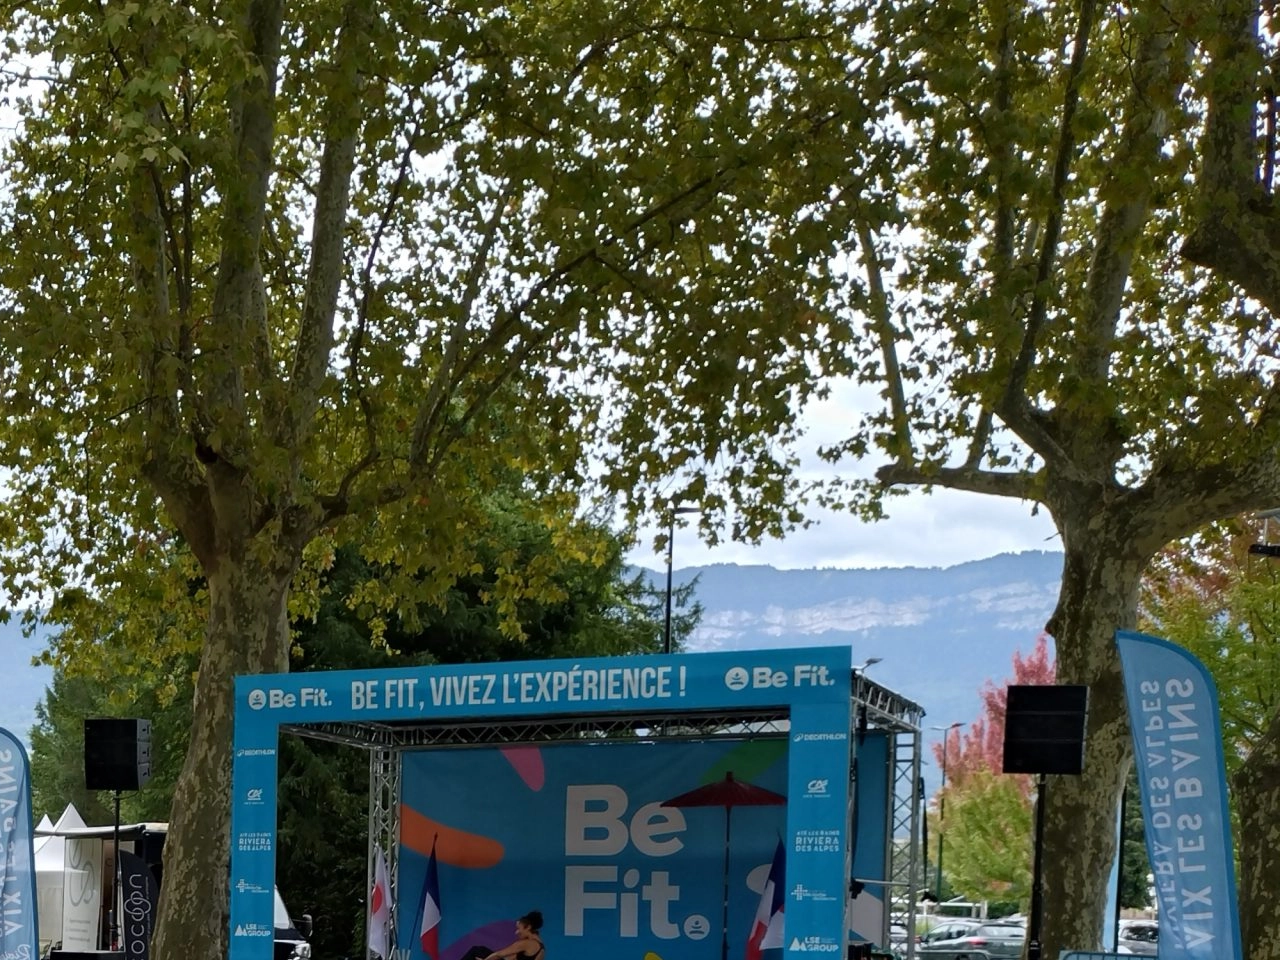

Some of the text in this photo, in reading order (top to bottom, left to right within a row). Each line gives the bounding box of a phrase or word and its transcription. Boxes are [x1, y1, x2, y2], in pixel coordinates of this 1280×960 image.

[351, 681, 378, 710] BE
[385, 678, 425, 711] FIT,
[430, 674, 497, 706] VIVEZ
[503, 663, 672, 704] L'EXPÉRIENCE
[752, 665, 836, 689] Be Fit.
[269, 687, 333, 708] Be Fit.
[565, 784, 688, 857] Be
[795, 836, 839, 845] RIVIERA
[807, 943, 839, 952] GROUP
